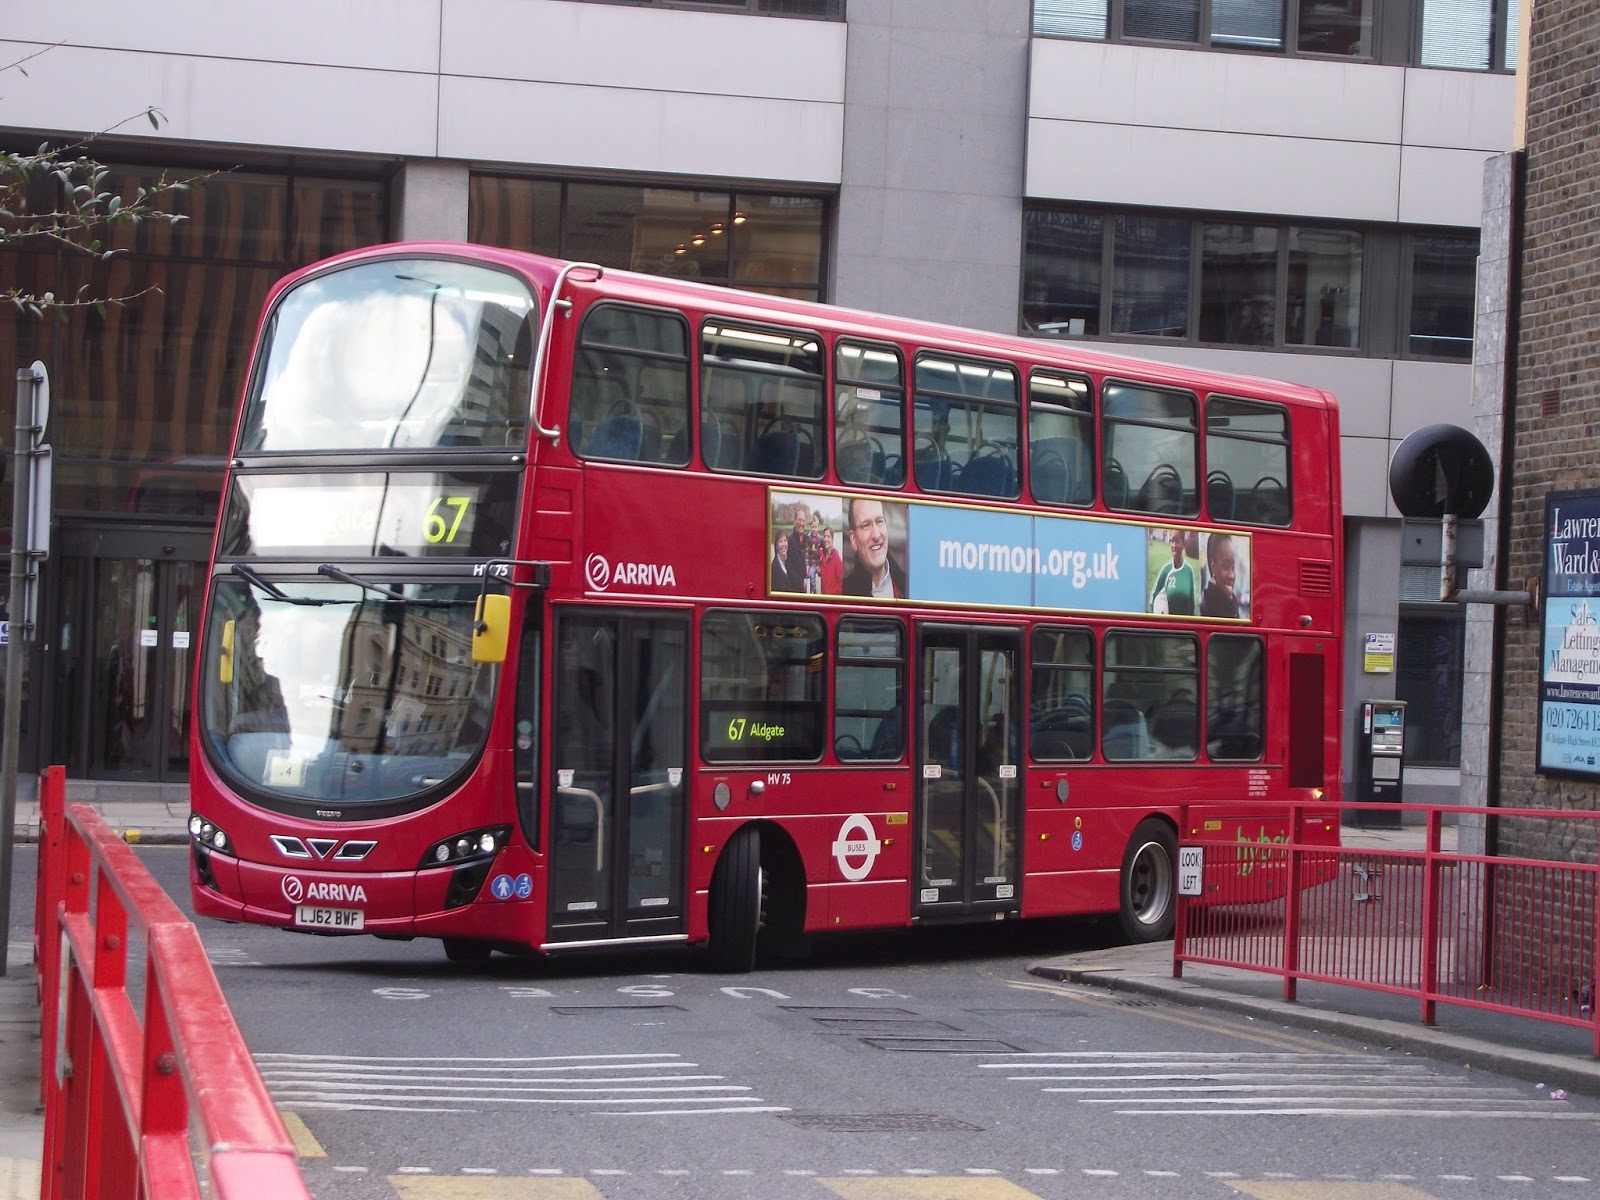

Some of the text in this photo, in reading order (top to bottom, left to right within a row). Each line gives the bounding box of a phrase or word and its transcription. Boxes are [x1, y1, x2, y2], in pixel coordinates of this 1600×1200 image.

[423, 497, 471, 543] 67
[939, 539, 1120, 589] mormon.org.uk
[1553, 541, 1589, 574] Ward
[494, 564, 510, 577] 75
[613, 562, 676, 587] ARRIVA
[1168, 576, 1176, 588] 22
[1570, 603, 1597, 627] Sales
[1551, 649, 1600, 680] Managem
[1546, 707, 1564, 728] 020
[1566, 708, 1589, 731] 7264
[728, 718, 785, 741] 67 Aldgate
[767, 773, 791, 785] HV 75
[316, 809, 342, 818] VOLVO
[847, 843, 866, 852] BUSES
[1182, 852, 1200, 867] LOOK
[307, 882, 368, 902] ARRIVA
[1183, 875, 1197, 890] LEFT
[300, 908, 359, 927] LJ62 BWF
